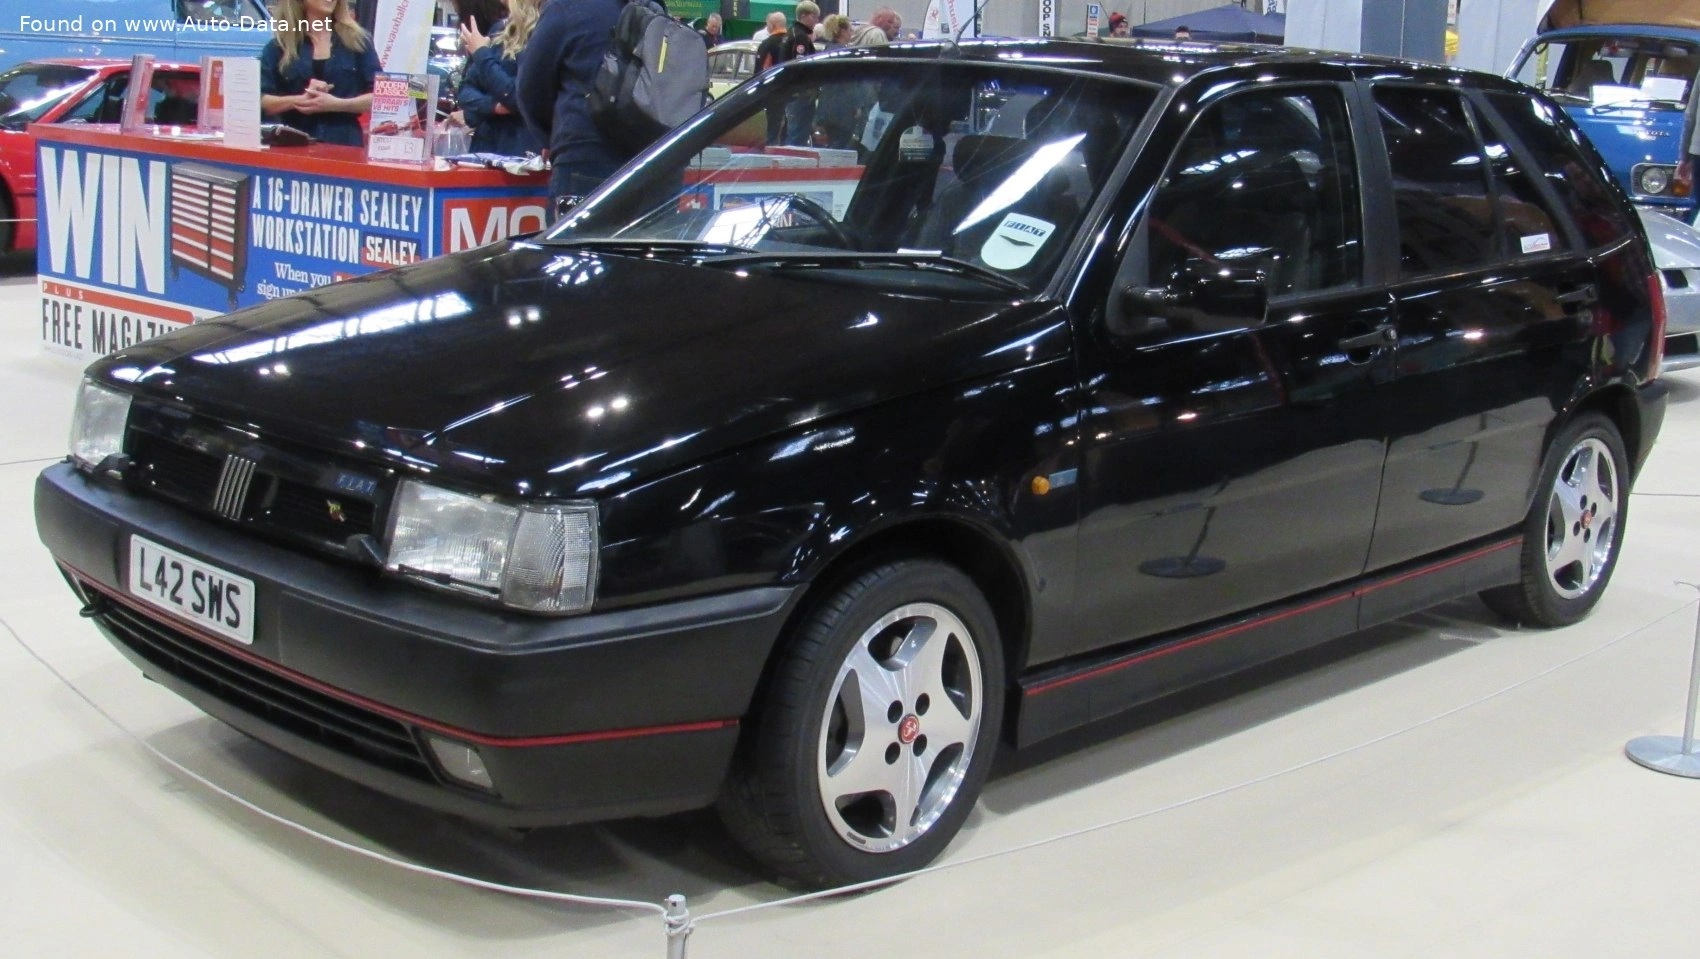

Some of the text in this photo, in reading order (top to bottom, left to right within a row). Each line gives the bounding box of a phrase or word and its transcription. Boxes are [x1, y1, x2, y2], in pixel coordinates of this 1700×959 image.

[375, 80, 409, 91] MODERN
[375, 88, 409, 98] CLASSICS
[252, 175, 423, 233] A 16-DRAWER SEALEY
[40, 146, 166, 295] WIN
[1003, 220, 1047, 237] FIAT
[252, 213, 360, 265] WORKSTATION
[366, 235, 417, 266] SEALEY
[274, 262, 331, 288] When you
[43, 280, 85, 300] PLUS
[257, 279, 280, 300] sign
[42, 298, 83, 350] FREE
[337, 472, 377, 493] FIAT
[140, 546, 241, 629] L42 SWS
